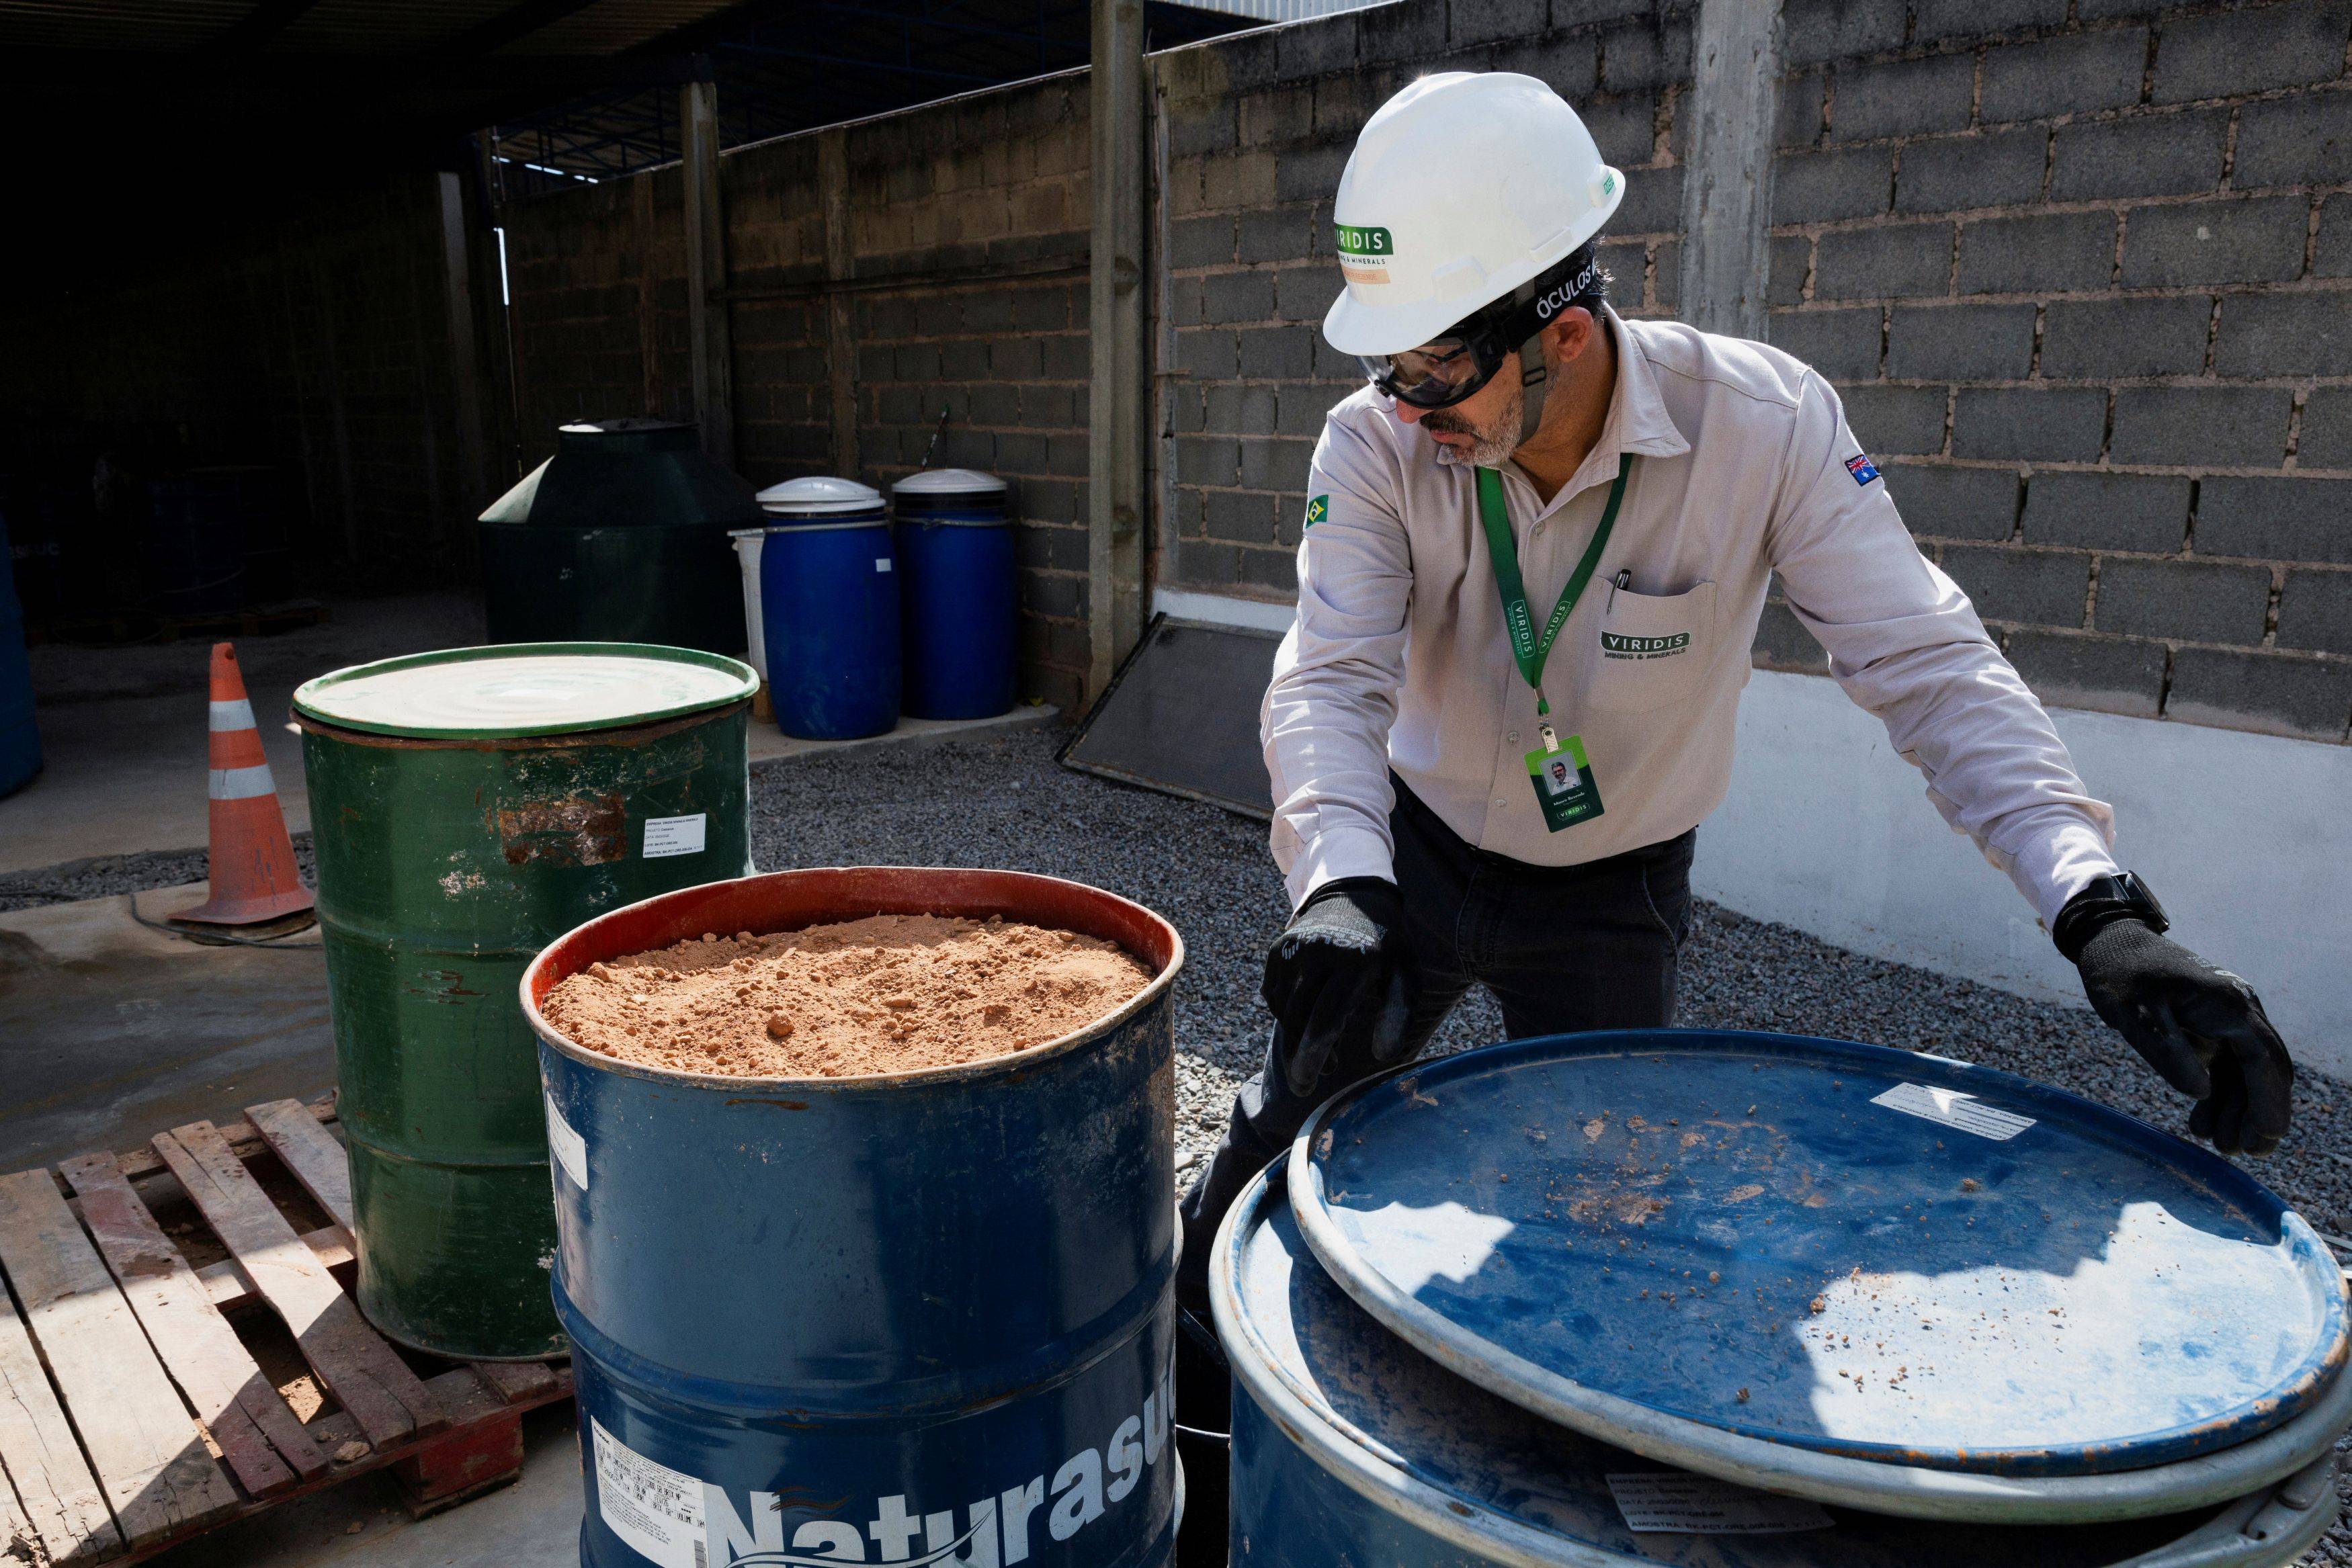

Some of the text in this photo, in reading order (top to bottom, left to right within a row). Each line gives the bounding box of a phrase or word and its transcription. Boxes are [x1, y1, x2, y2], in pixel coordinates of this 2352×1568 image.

[1335, 229, 1383, 249] IRIDIS
[1515, 606, 1532, 652] VIRIDIS
[1542, 605, 1565, 648] VIRIDIS
[1609, 636, 1684, 650] VIRIDIS
[1605, 652, 1634, 660] MINING
[1646, 648, 1686, 659] MINERALS
[1560, 804, 1587, 818] VIRIDIS
